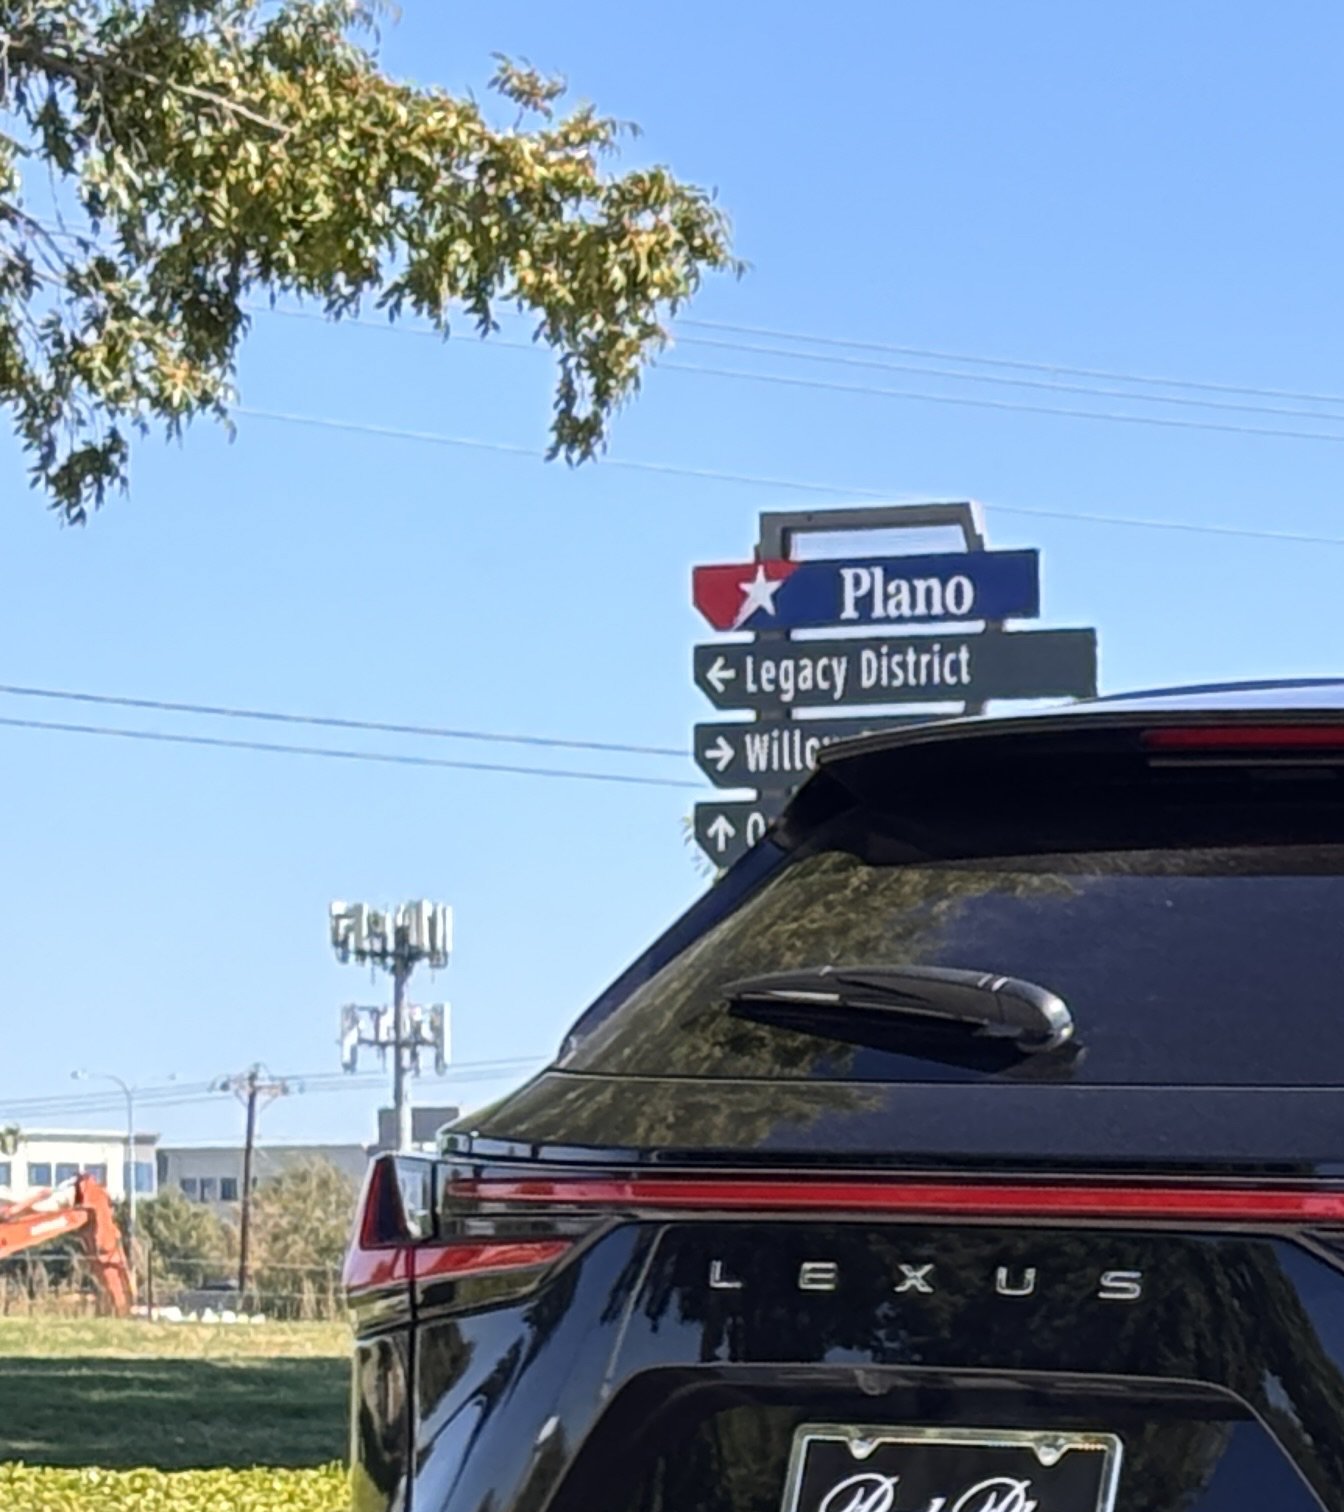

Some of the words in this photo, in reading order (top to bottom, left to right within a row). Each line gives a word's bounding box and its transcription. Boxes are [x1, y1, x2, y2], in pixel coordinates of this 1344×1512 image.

[840, 566, 974, 620] Plano
[746, 653, 847, 700] Legacy
[861, 645, 971, 688] District
[709, 1260, 1143, 1300] LEXUS
